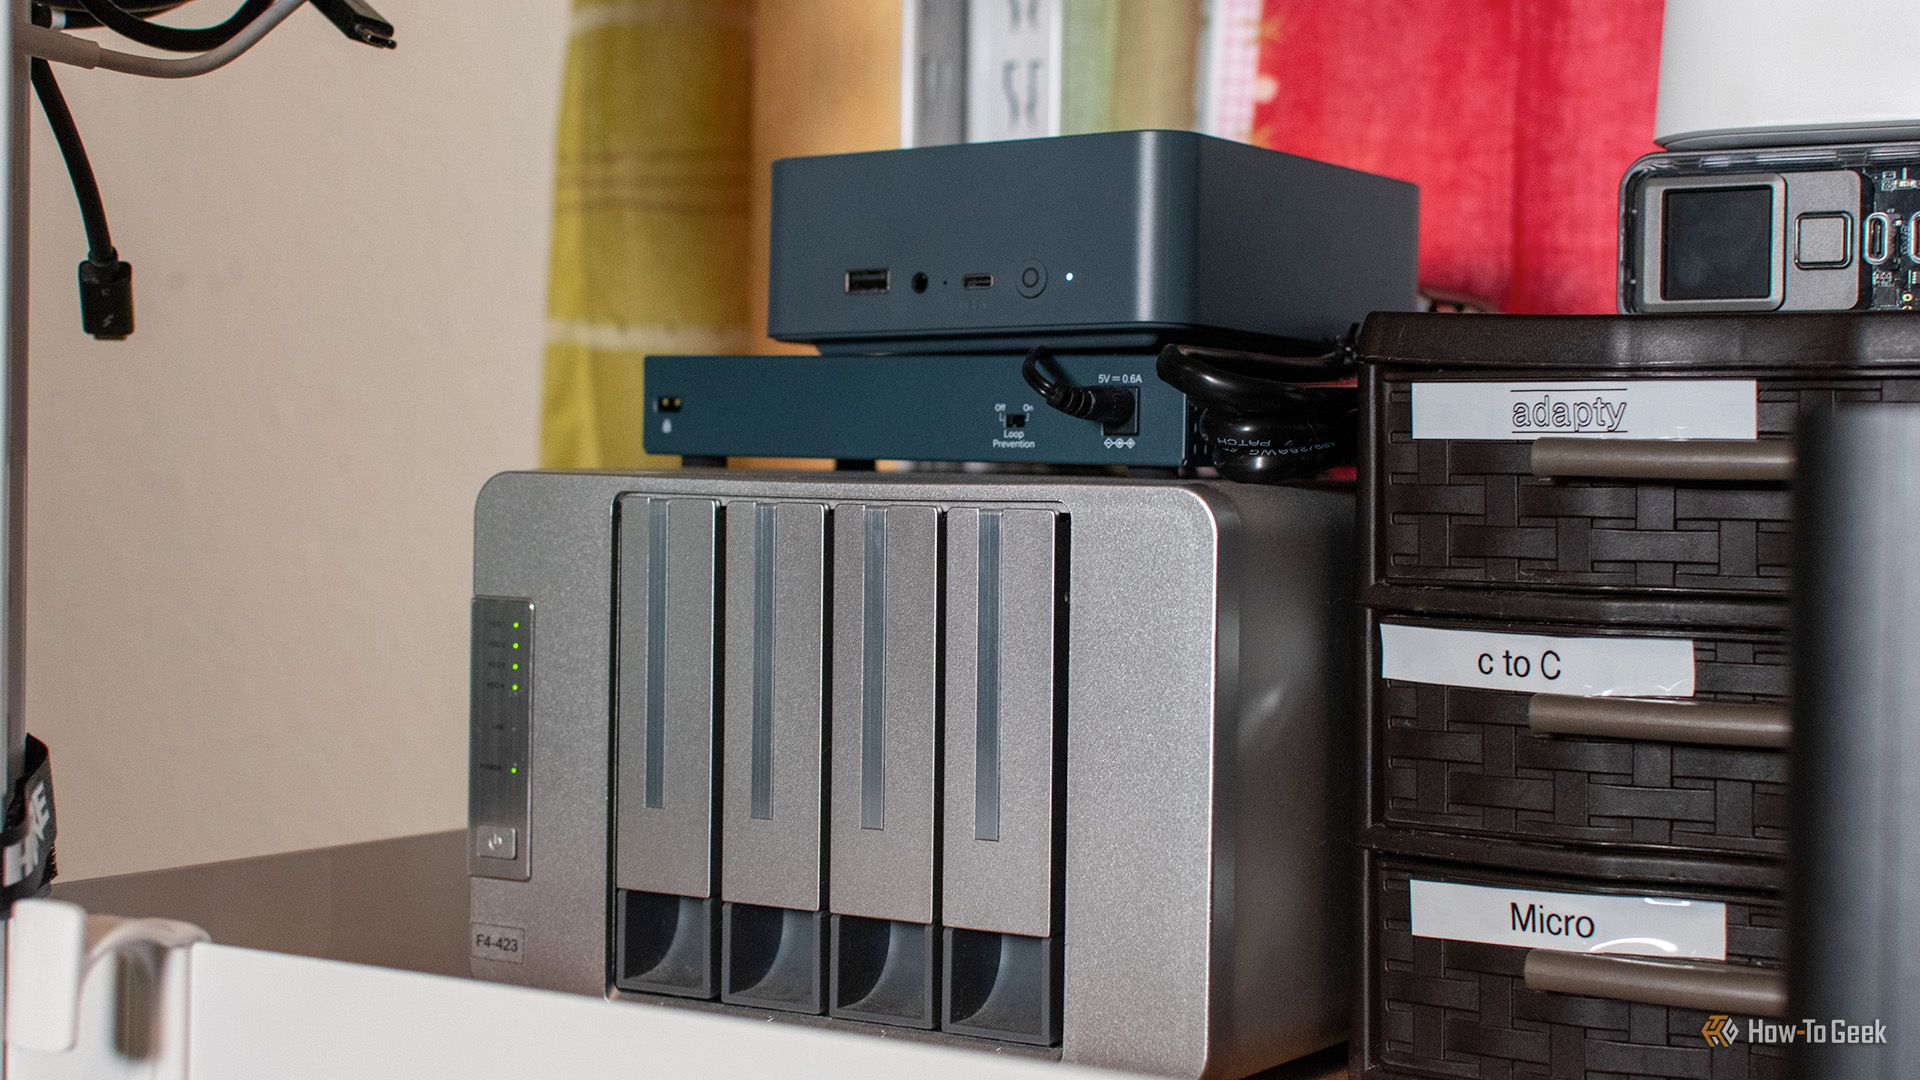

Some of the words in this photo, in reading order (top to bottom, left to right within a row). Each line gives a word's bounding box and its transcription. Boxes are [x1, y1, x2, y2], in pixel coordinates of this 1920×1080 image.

[1098, 374, 1110, 383] 5V
[1122, 374, 1143, 383] 0.6A
[995, 403, 1007, 412] Off
[1022, 403, 1034, 412] On
[1512, 394, 1628, 433] adapty
[1003, 430, 1025, 440] Loop
[992, 439, 1036, 449] Prevention
[1478, 652, 1494, 675] c
[1502, 649, 1531, 678] to
[1540, 649, 1561, 680] C
[1510, 901, 1595, 939] Micro
[476, 934, 518, 953] F4-423
